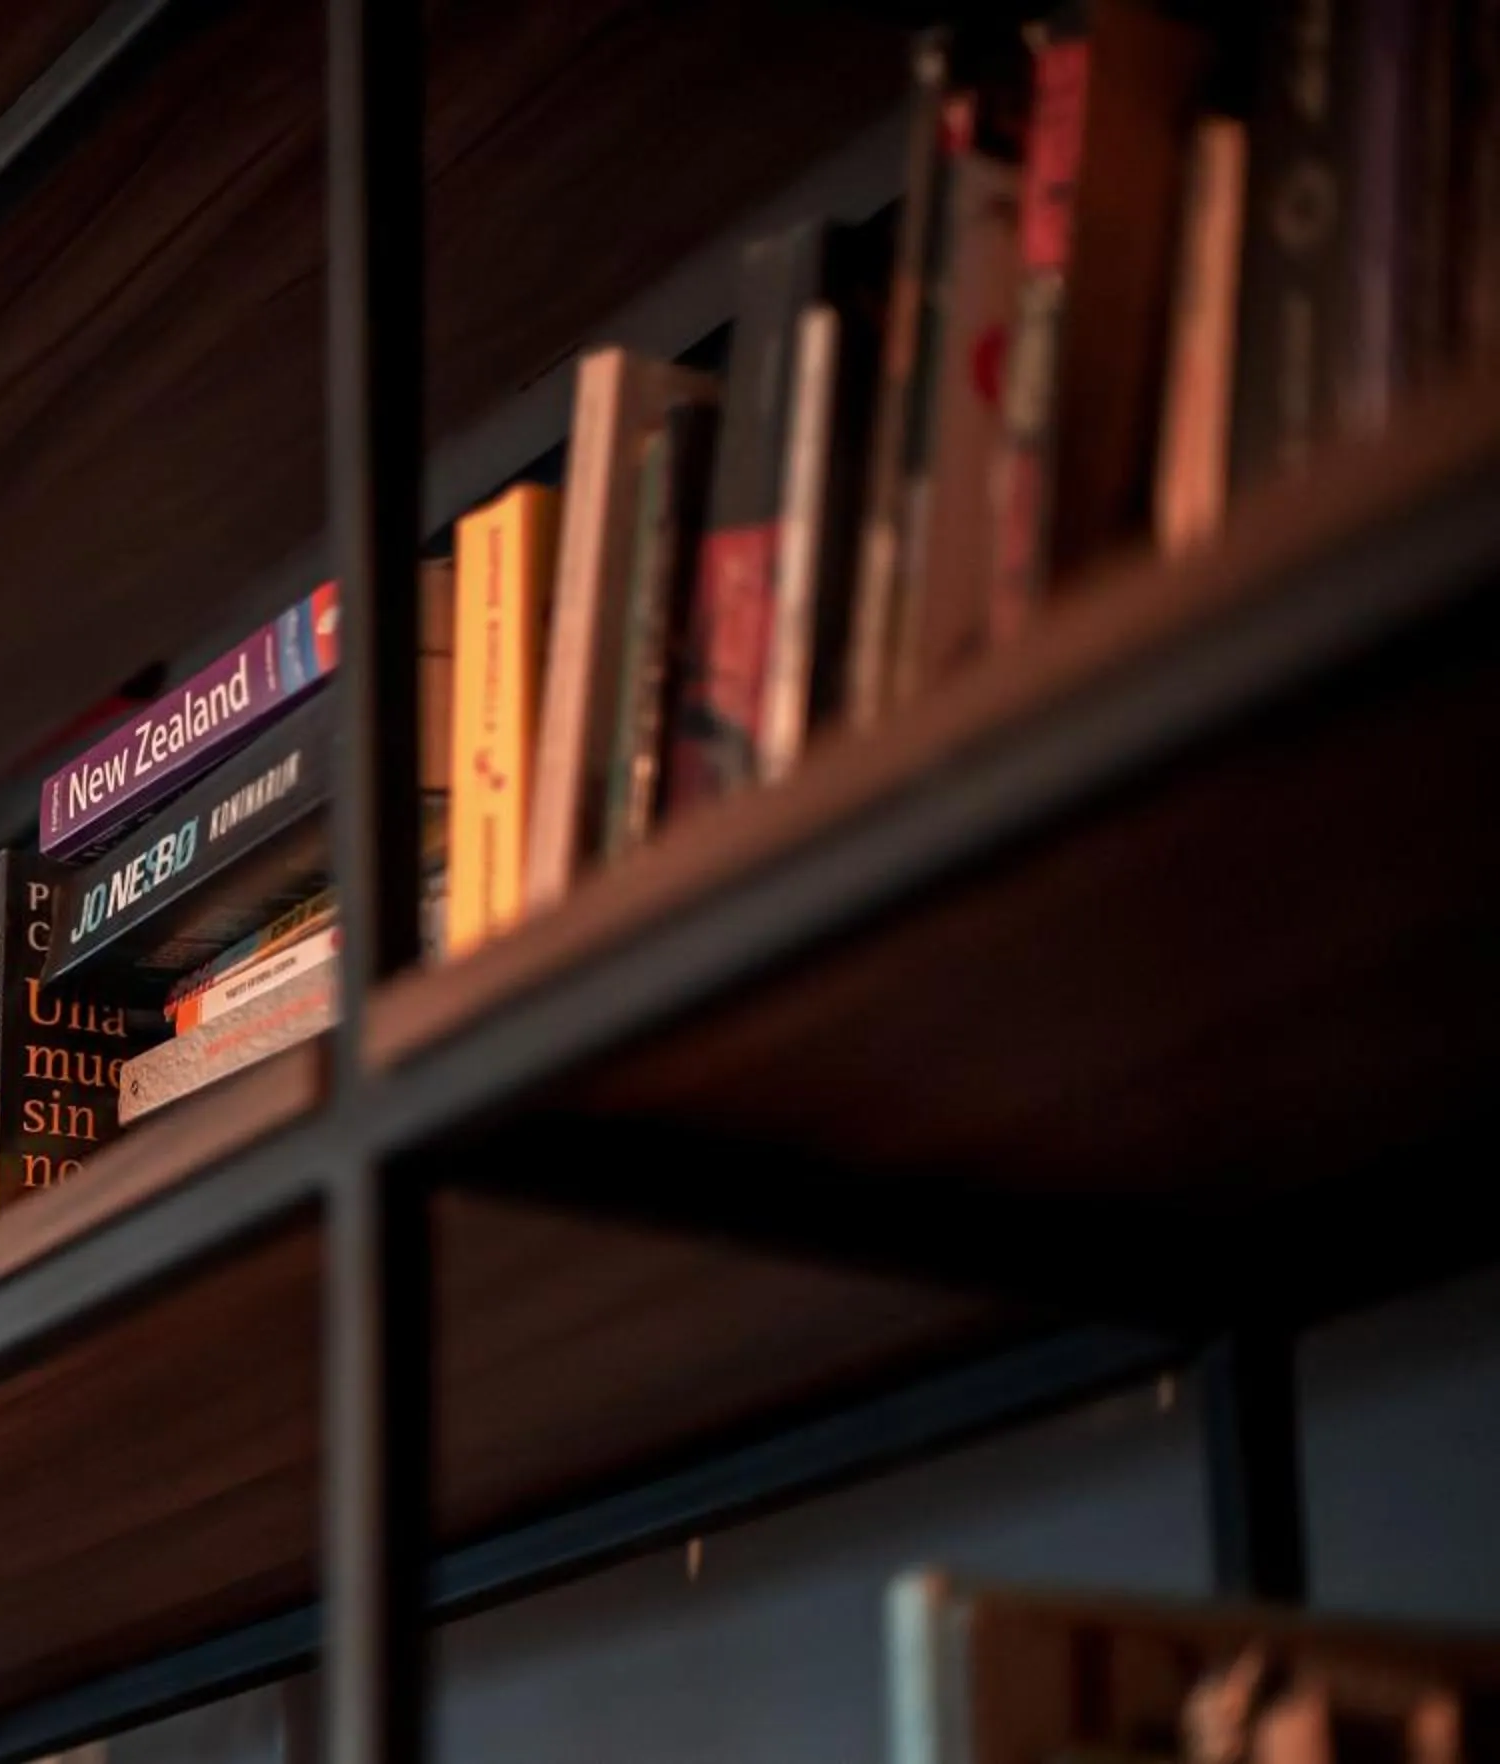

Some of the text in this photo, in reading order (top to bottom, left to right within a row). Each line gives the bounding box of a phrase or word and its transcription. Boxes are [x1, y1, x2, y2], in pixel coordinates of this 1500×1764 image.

[69, 747, 129, 819] New
[133, 652, 250, 768] Zealand
[69, 882, 108, 945] JO
[22, 1088, 98, 1142] sin
